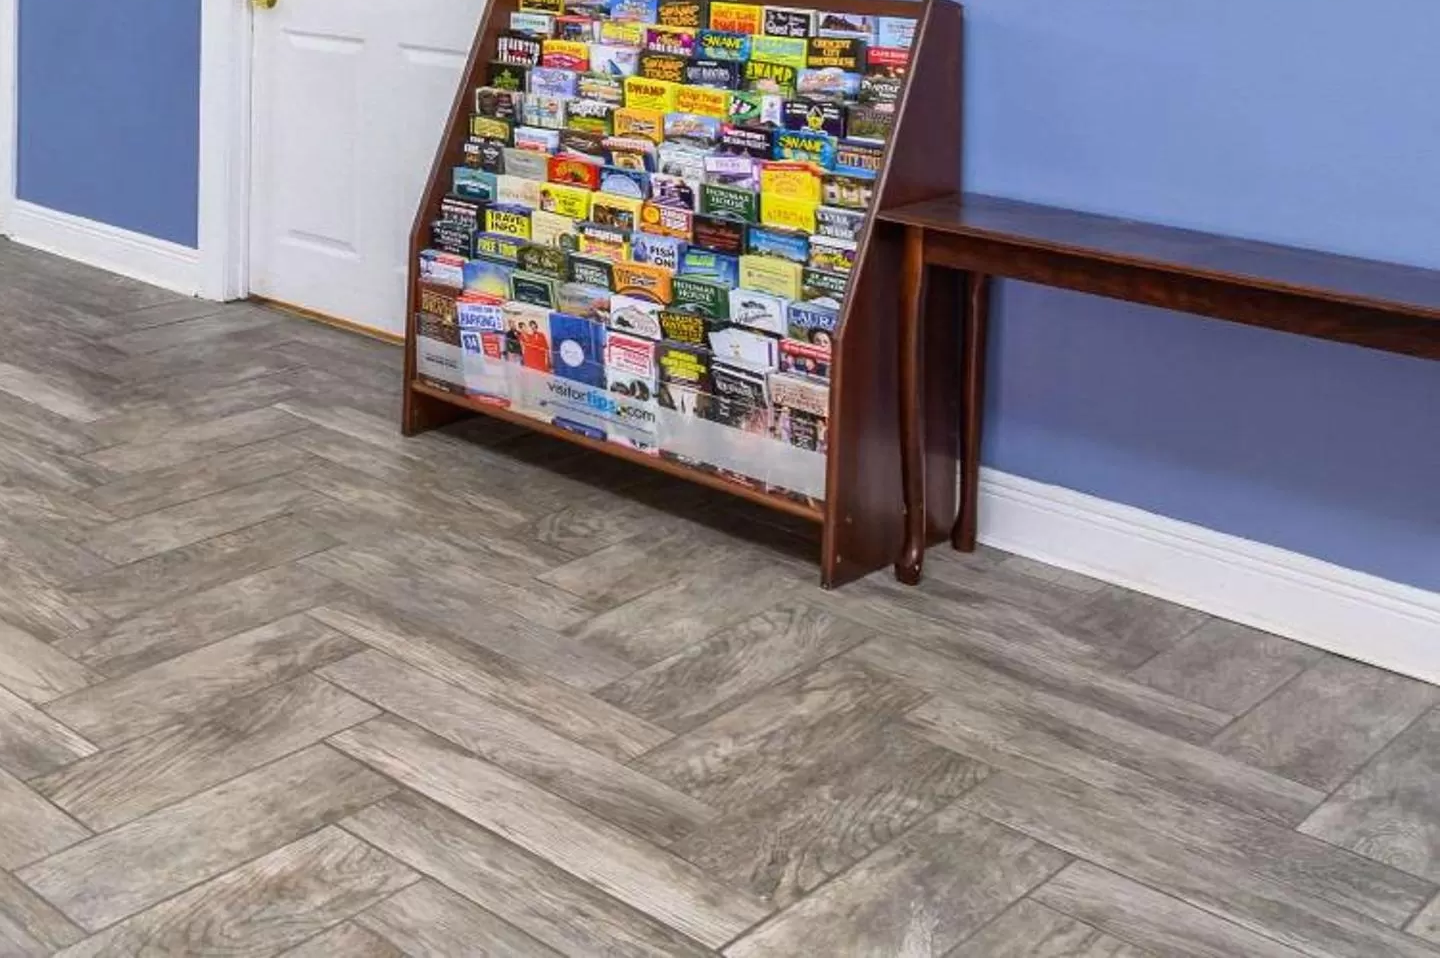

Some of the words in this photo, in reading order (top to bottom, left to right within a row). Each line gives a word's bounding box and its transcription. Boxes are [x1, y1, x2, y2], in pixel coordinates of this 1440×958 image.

[745, 61, 793, 83] SWAMP
[626, 82, 667, 97] SWAMP
[710, 195, 746, 209] HOUSE
[490, 220, 517, 234] INFO
[650, 245, 676, 259] FISH
[679, 288, 711, 302] HOUSE
[548, 378, 656, 423] visitortips.com
